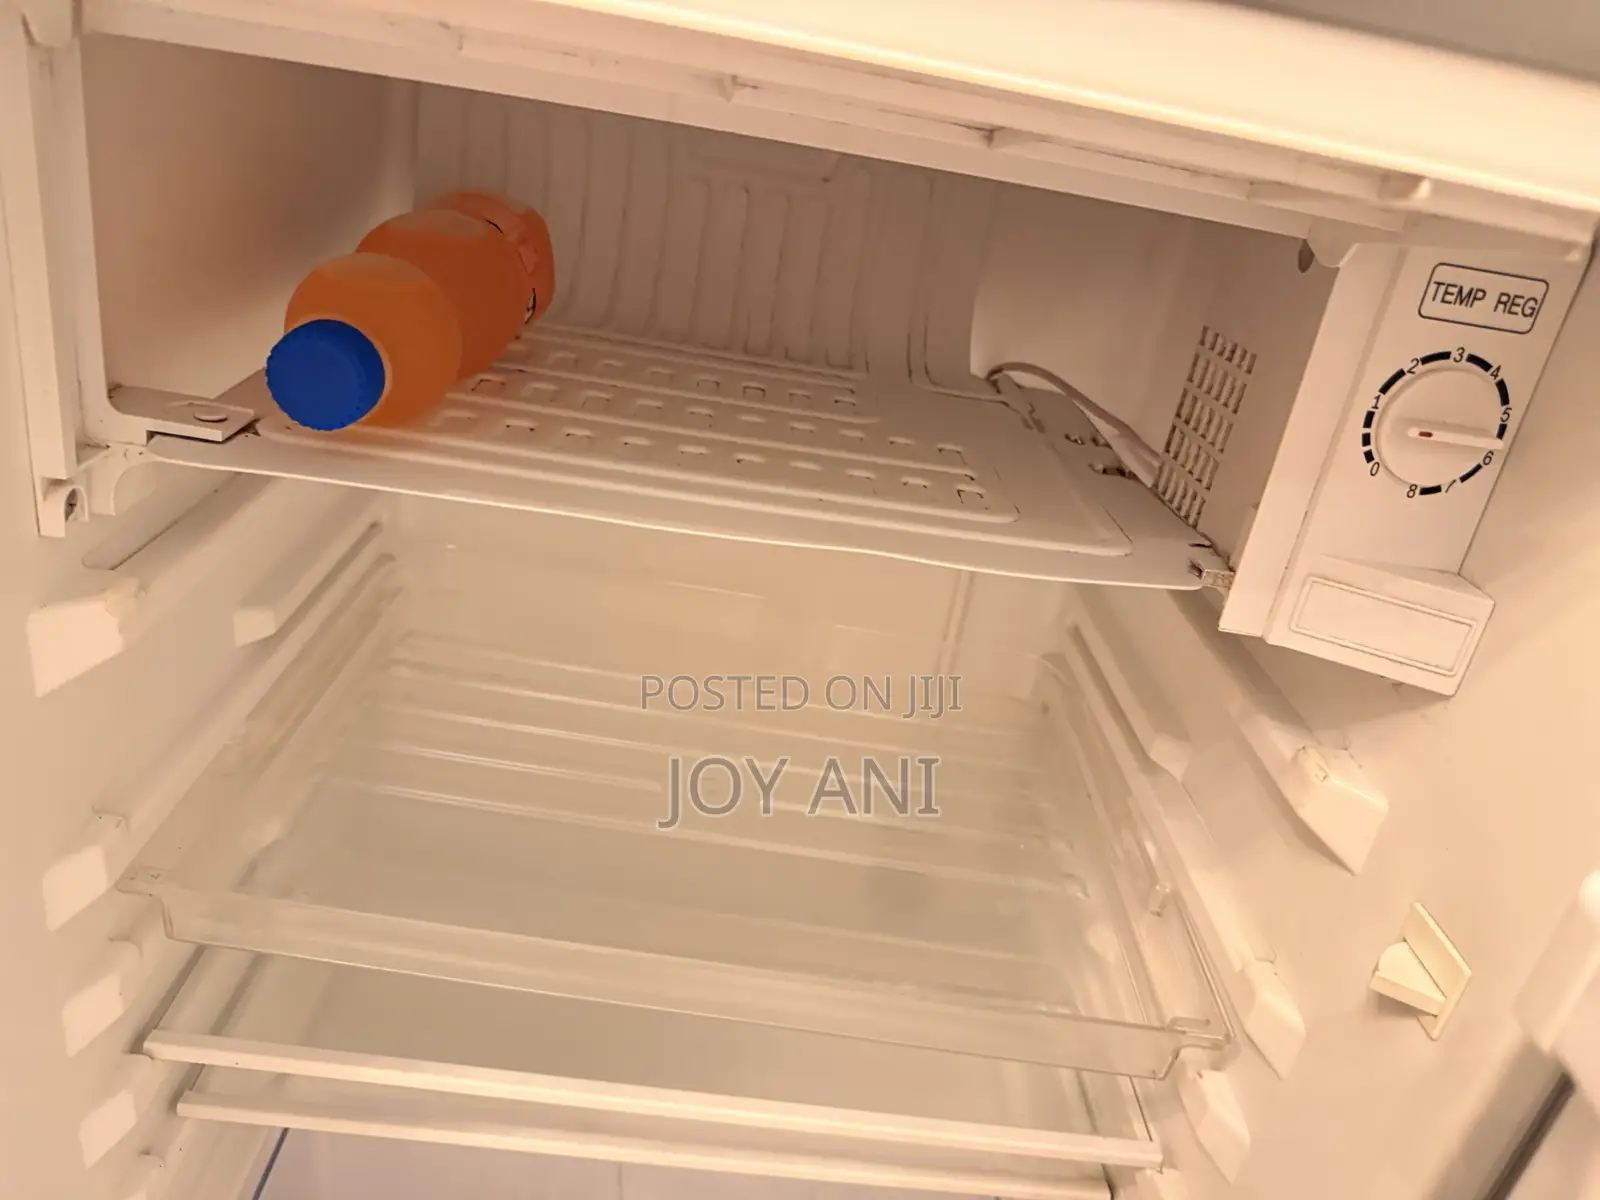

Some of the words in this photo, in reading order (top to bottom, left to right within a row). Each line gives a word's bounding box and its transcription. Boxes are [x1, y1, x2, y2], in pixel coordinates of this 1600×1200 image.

[1432, 281, 1486, 308] TEMP
[1493, 292, 1539, 318] REG
[1453, 347, 1466, 363] 3
[1406, 358, 1420, 375] 2
[1490, 365, 1502, 380] 4
[1371, 394, 1382, 410] 1
[1500, 407, 1513, 423] 5
[1482, 450, 1495, 466] 6
[1369, 461, 1381, 477] 0
[1406, 484, 1418, 499] 8
